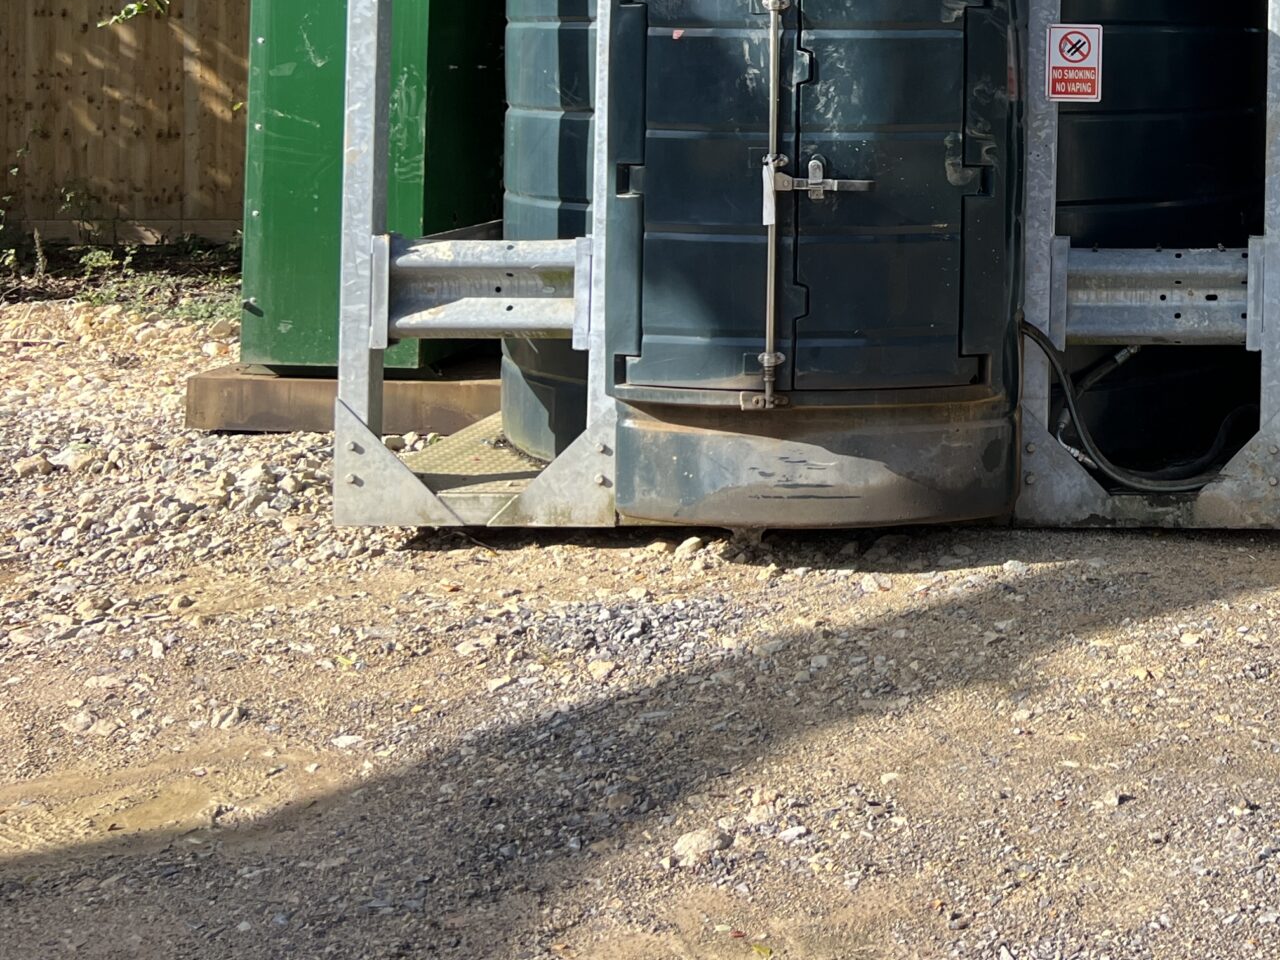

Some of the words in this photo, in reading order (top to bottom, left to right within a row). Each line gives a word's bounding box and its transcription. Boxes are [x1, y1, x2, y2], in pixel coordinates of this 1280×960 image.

[1052, 69, 1063, 79] NO
[1063, 69, 1096, 80] SMOKING
[1055, 82, 1066, 92] NO
[1067, 82, 1092, 93] VAPING
